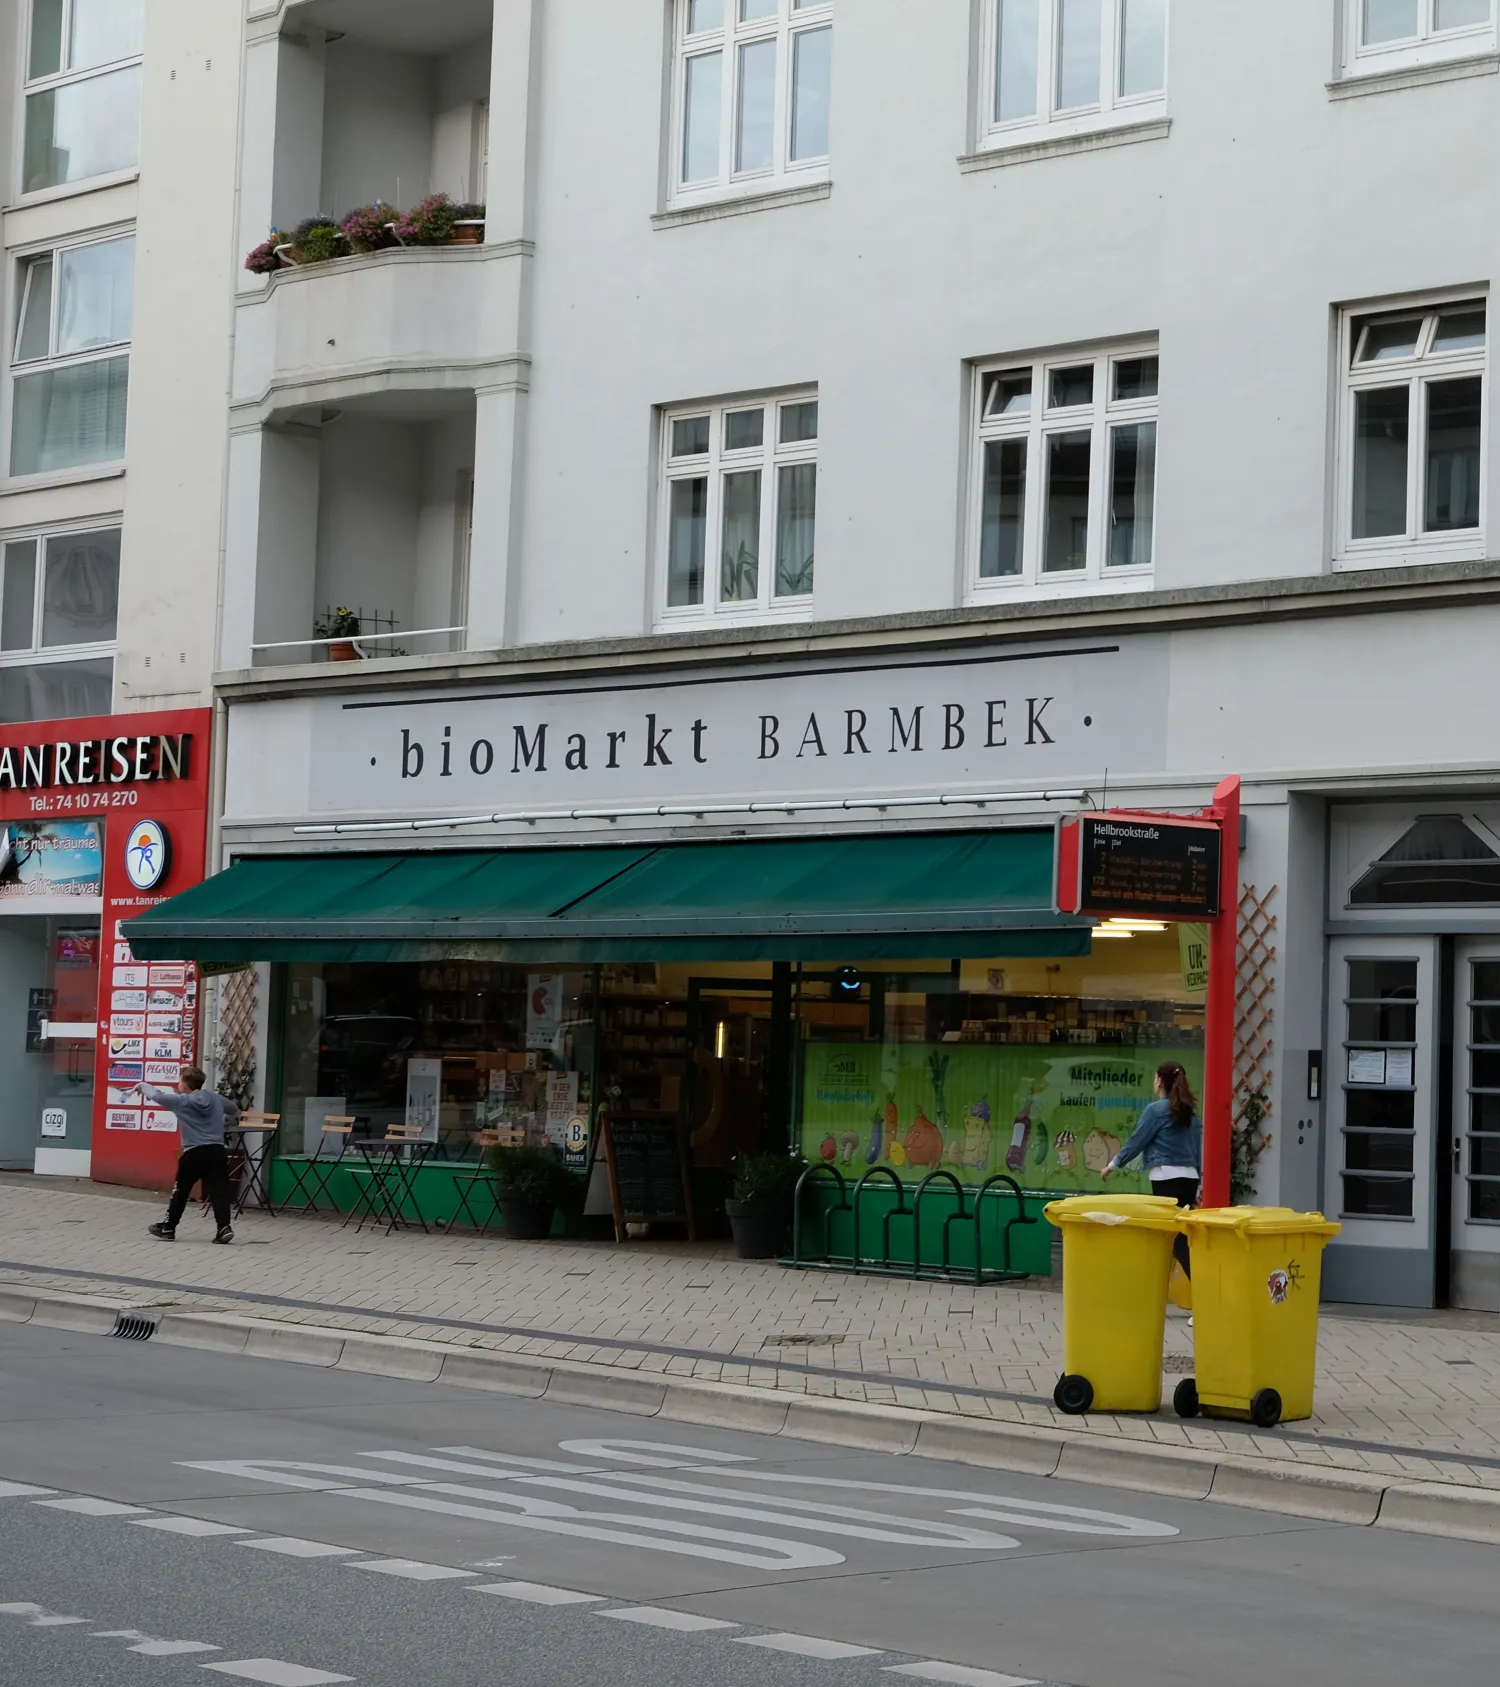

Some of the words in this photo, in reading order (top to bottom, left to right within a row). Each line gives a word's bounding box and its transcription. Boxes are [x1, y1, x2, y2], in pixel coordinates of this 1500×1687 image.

[401, 713, 708, 779] bioMarkt
[757, 696, 1056, 760] BARMBEK
[54, 733, 187, 786] REISEN
[29, 796, 53, 811] Tel.:
[56, 795, 72, 810] 74
[75, 793, 89, 809] 10
[92, 792, 108, 807] 74
[112, 790, 138, 806] 270
[1093, 823, 1160, 840] Hellbrookstraße
[31, 838, 49, 850] nur
[53, 879, 77, 895] mal
[110, 895, 172, 906] www.tanreis
[154, 1049, 172, 1057] KLM
[146, 1064, 178, 1075] PEGASUS
[1070, 1067, 1144, 1090] Mitglieder
[1060, 1092, 1096, 1107] kaufen
[572, 1124, 581, 1142] B
